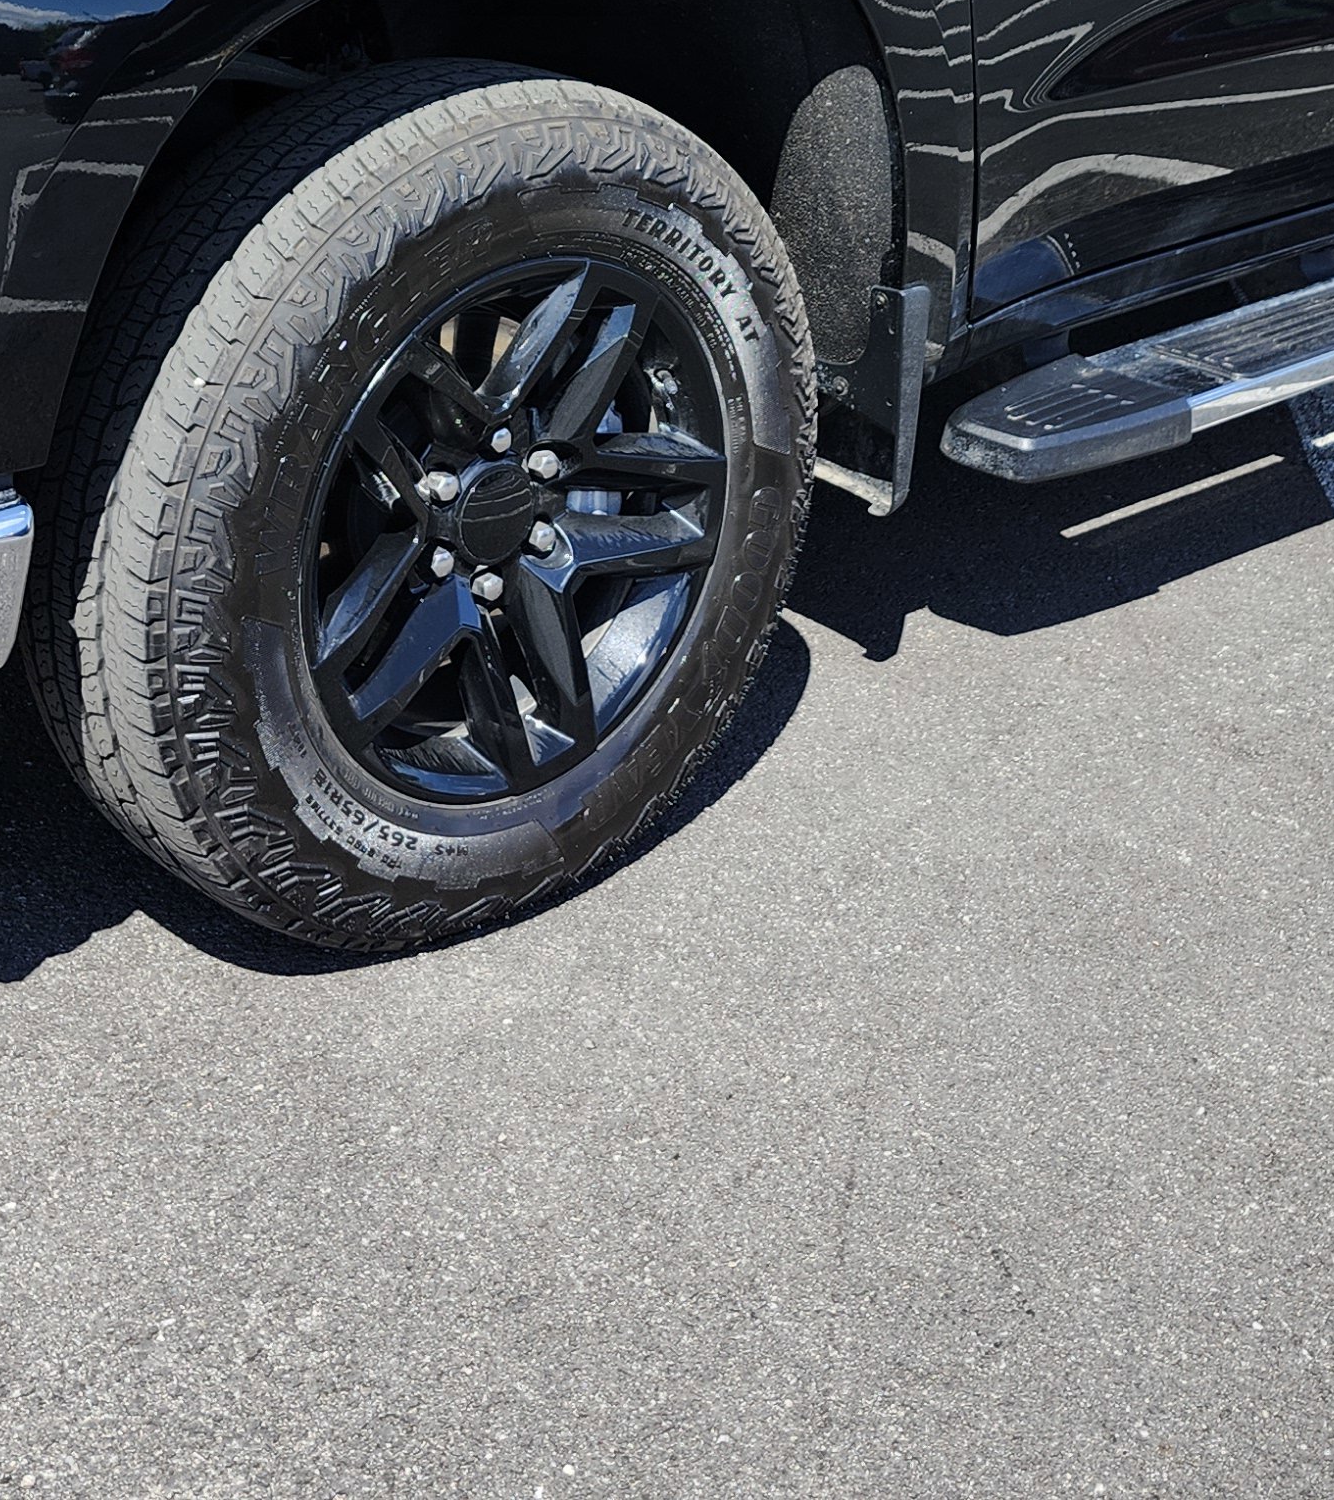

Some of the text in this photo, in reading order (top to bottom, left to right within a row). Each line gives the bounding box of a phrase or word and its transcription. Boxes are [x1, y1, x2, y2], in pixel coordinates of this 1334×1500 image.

[255, 218, 497, 576] WRANGLER
[622, 208, 737, 298] TERRITORY
[736, 316, 760, 343] AT
[579, 486, 782, 832] GOODYEAR
